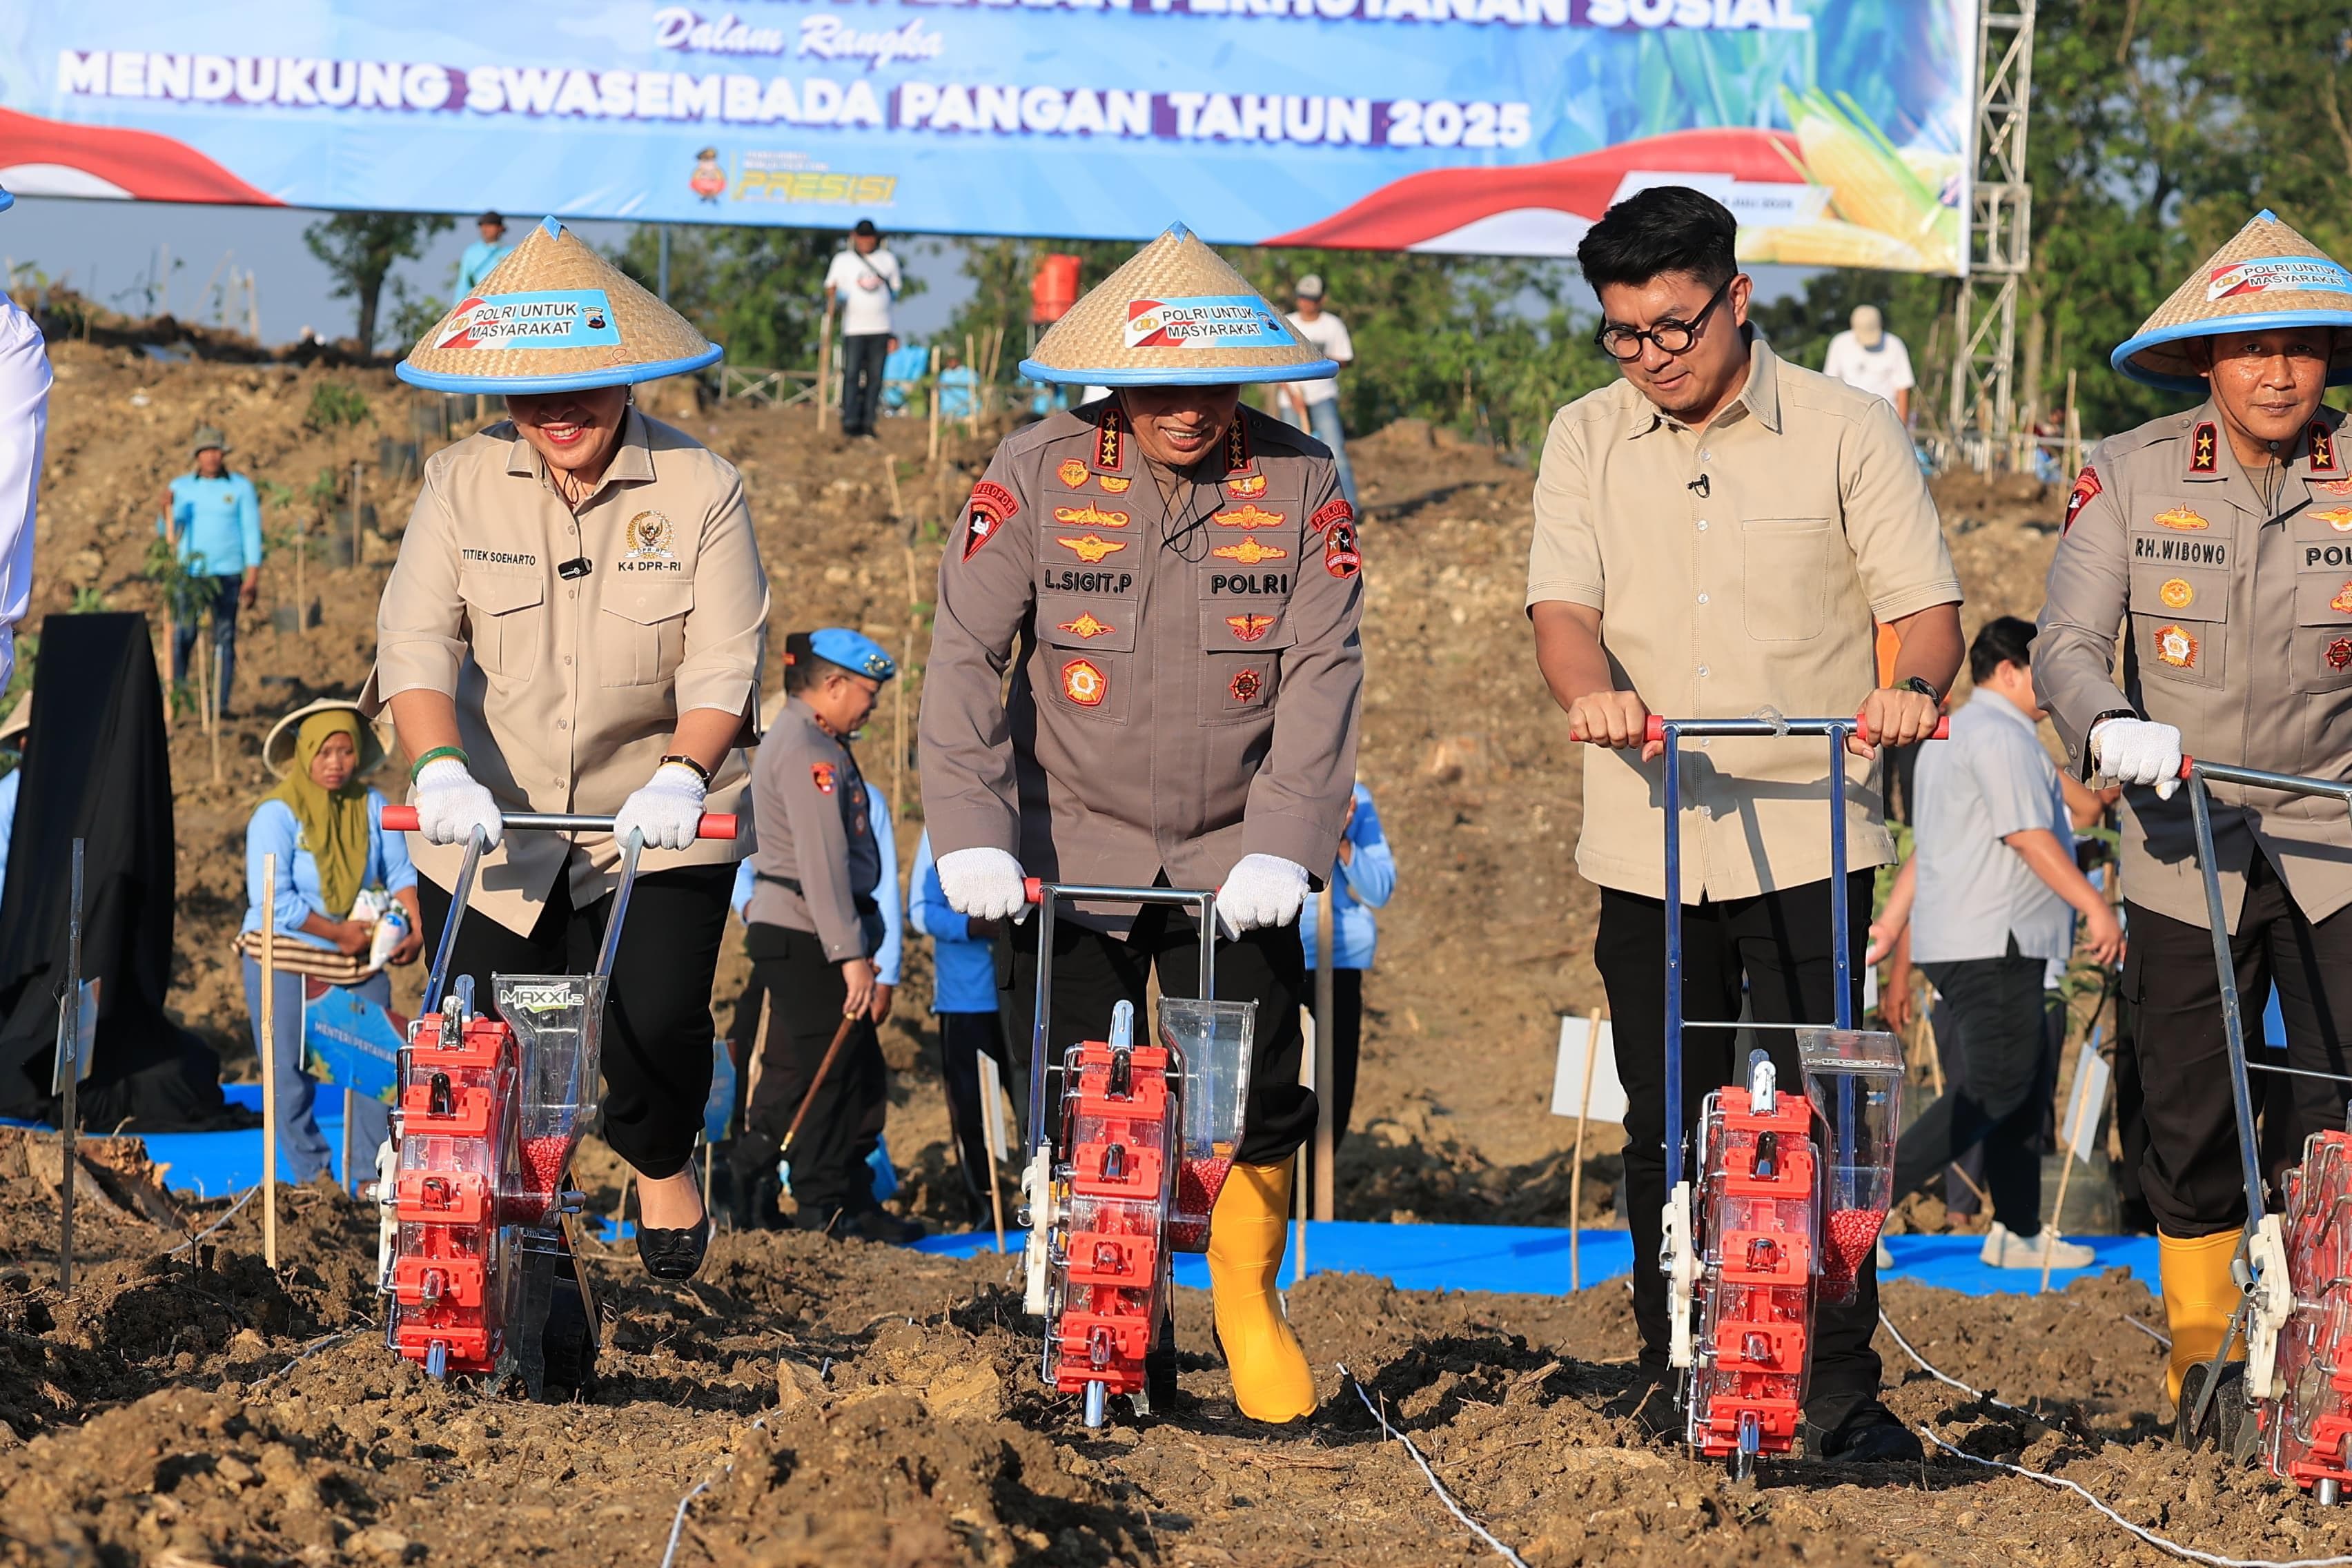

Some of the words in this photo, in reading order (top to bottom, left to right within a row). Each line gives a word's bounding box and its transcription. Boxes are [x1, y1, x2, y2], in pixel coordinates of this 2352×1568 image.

[1586, 0, 1811, 29] SOSIAL
[653, 6, 784, 55] Dalam
[797, 13, 944, 72] Rangka
[58, 50, 452, 109] MENDUKUNG
[464, 66, 883, 126] SWASEMBADA
[896, 81, 1150, 135] PANGAN
[1168, 92, 1372, 145] TAHUN
[1385, 100, 1532, 148] 2025
[2244, 263, 2290, 276] POLRI
[2294, 264, 2338, 276] UNTUK
[2250, 275, 2344, 286] MASYARAKAT
[473, 306, 516, 321] POLRI
[520, 304, 577, 317] UNTUK
[1162, 308, 1208, 322] POLRI
[1212, 307, 1253, 320] UNTUK
[469, 322, 571, 338] MASYARAKAT
[1167, 323, 1261, 337] MASYARAKAT
[462, 549, 489, 561] TITIEK
[491, 552, 536, 566] SOEHARTO
[2135, 538, 2226, 565] RH.WIBOWO
[618, 562, 634, 571] K4
[638, 561, 680, 571] DPR-RI
[1043, 569, 1132, 594] L.SIGIT.P
[1211, 574, 1288, 594] POLRI
